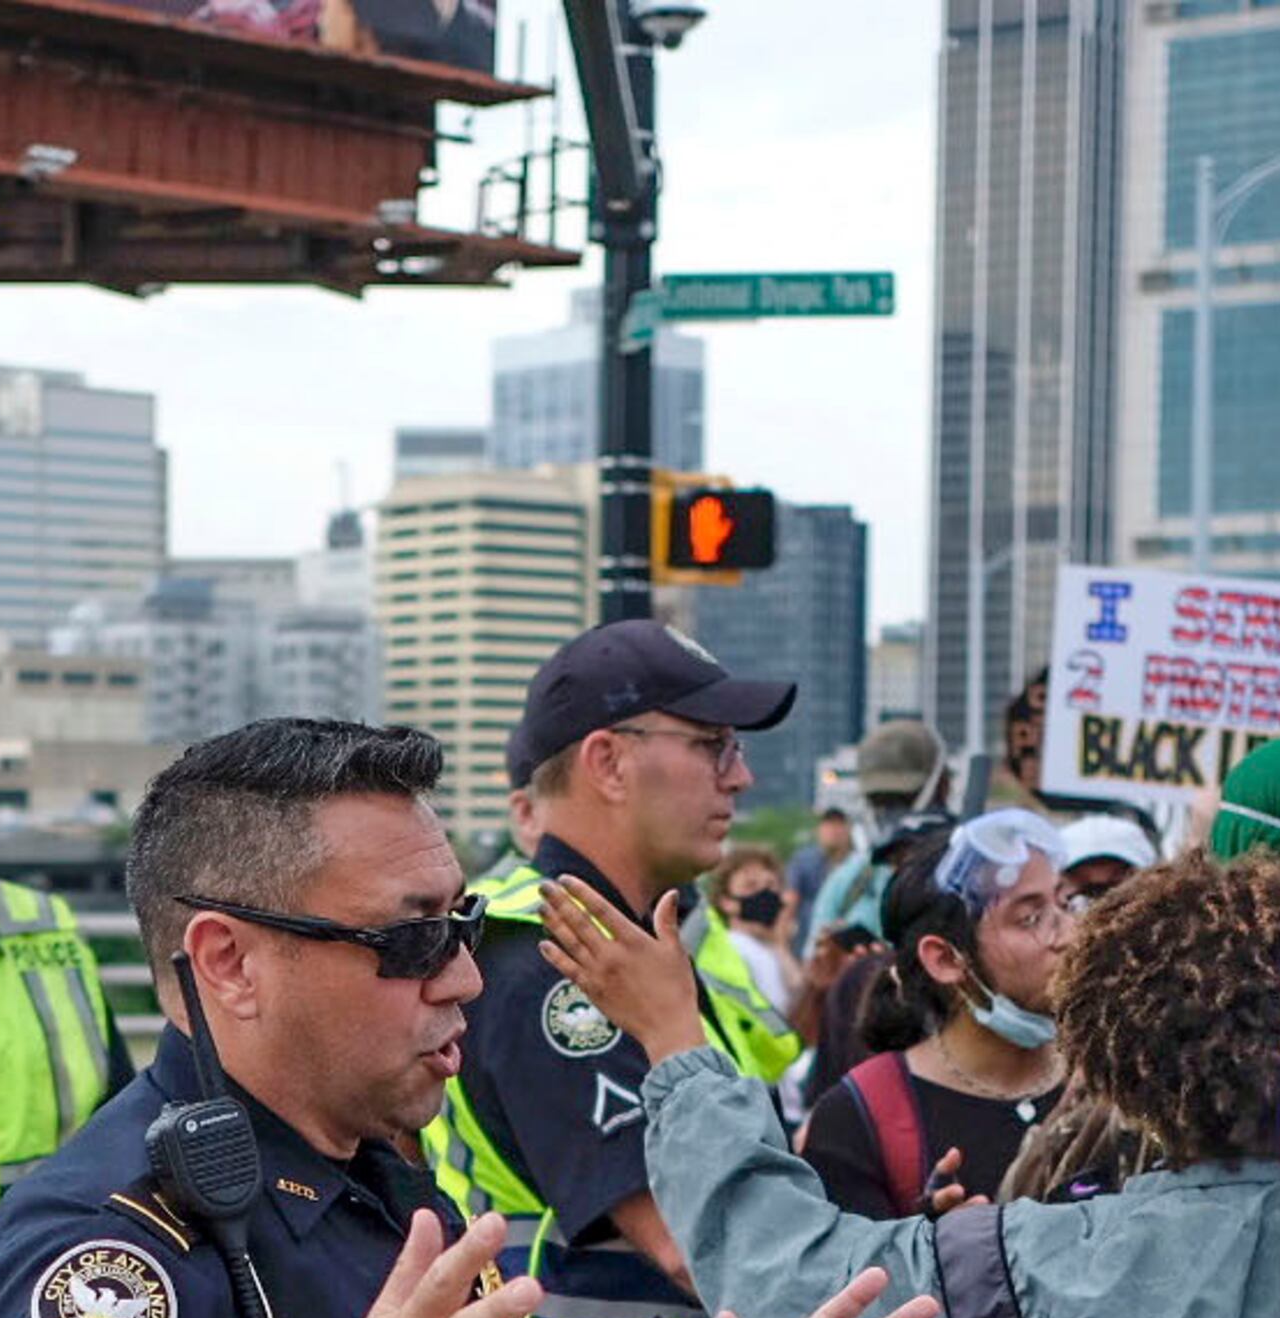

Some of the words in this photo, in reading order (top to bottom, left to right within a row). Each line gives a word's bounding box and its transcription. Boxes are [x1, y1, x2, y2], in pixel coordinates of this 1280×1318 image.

[1086, 581, 1132, 643] I
[1066, 649, 1104, 711] 2
[1079, 713, 1206, 787] BLACK
[44, 1262, 76, 1301] CITY
[79, 1250, 109, 1267] OF
